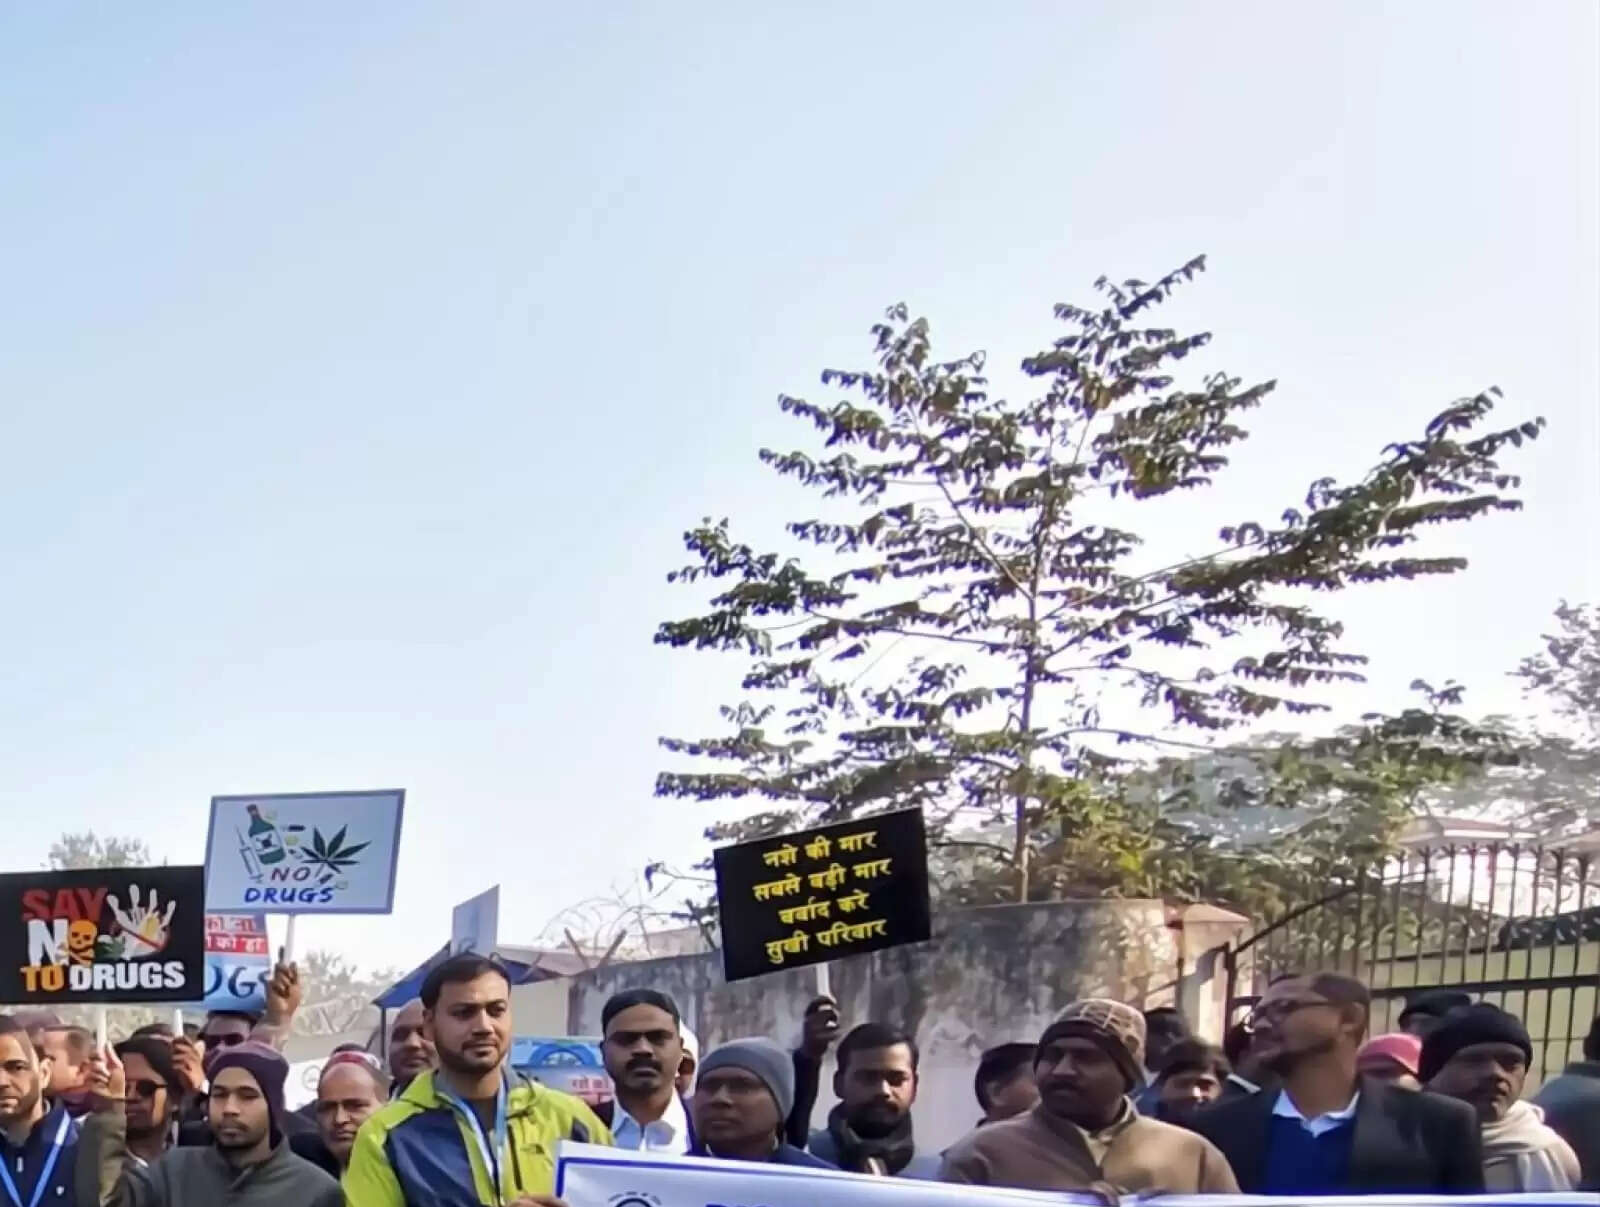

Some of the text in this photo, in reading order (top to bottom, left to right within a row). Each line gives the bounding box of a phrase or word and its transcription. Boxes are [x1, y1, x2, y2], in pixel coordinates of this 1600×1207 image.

[805, 835, 832, 860] की
[838, 831, 878, 852] मार
[271, 867, 311, 881] NO
[752, 873, 803, 901] सबसे
[852, 858, 892, 879] मार
[21, 887, 108, 921] SAY
[244, 887, 335, 904] DRUGS
[815, 919, 888, 947] परिवार
[20, 961, 186, 991] TO DRUGS
